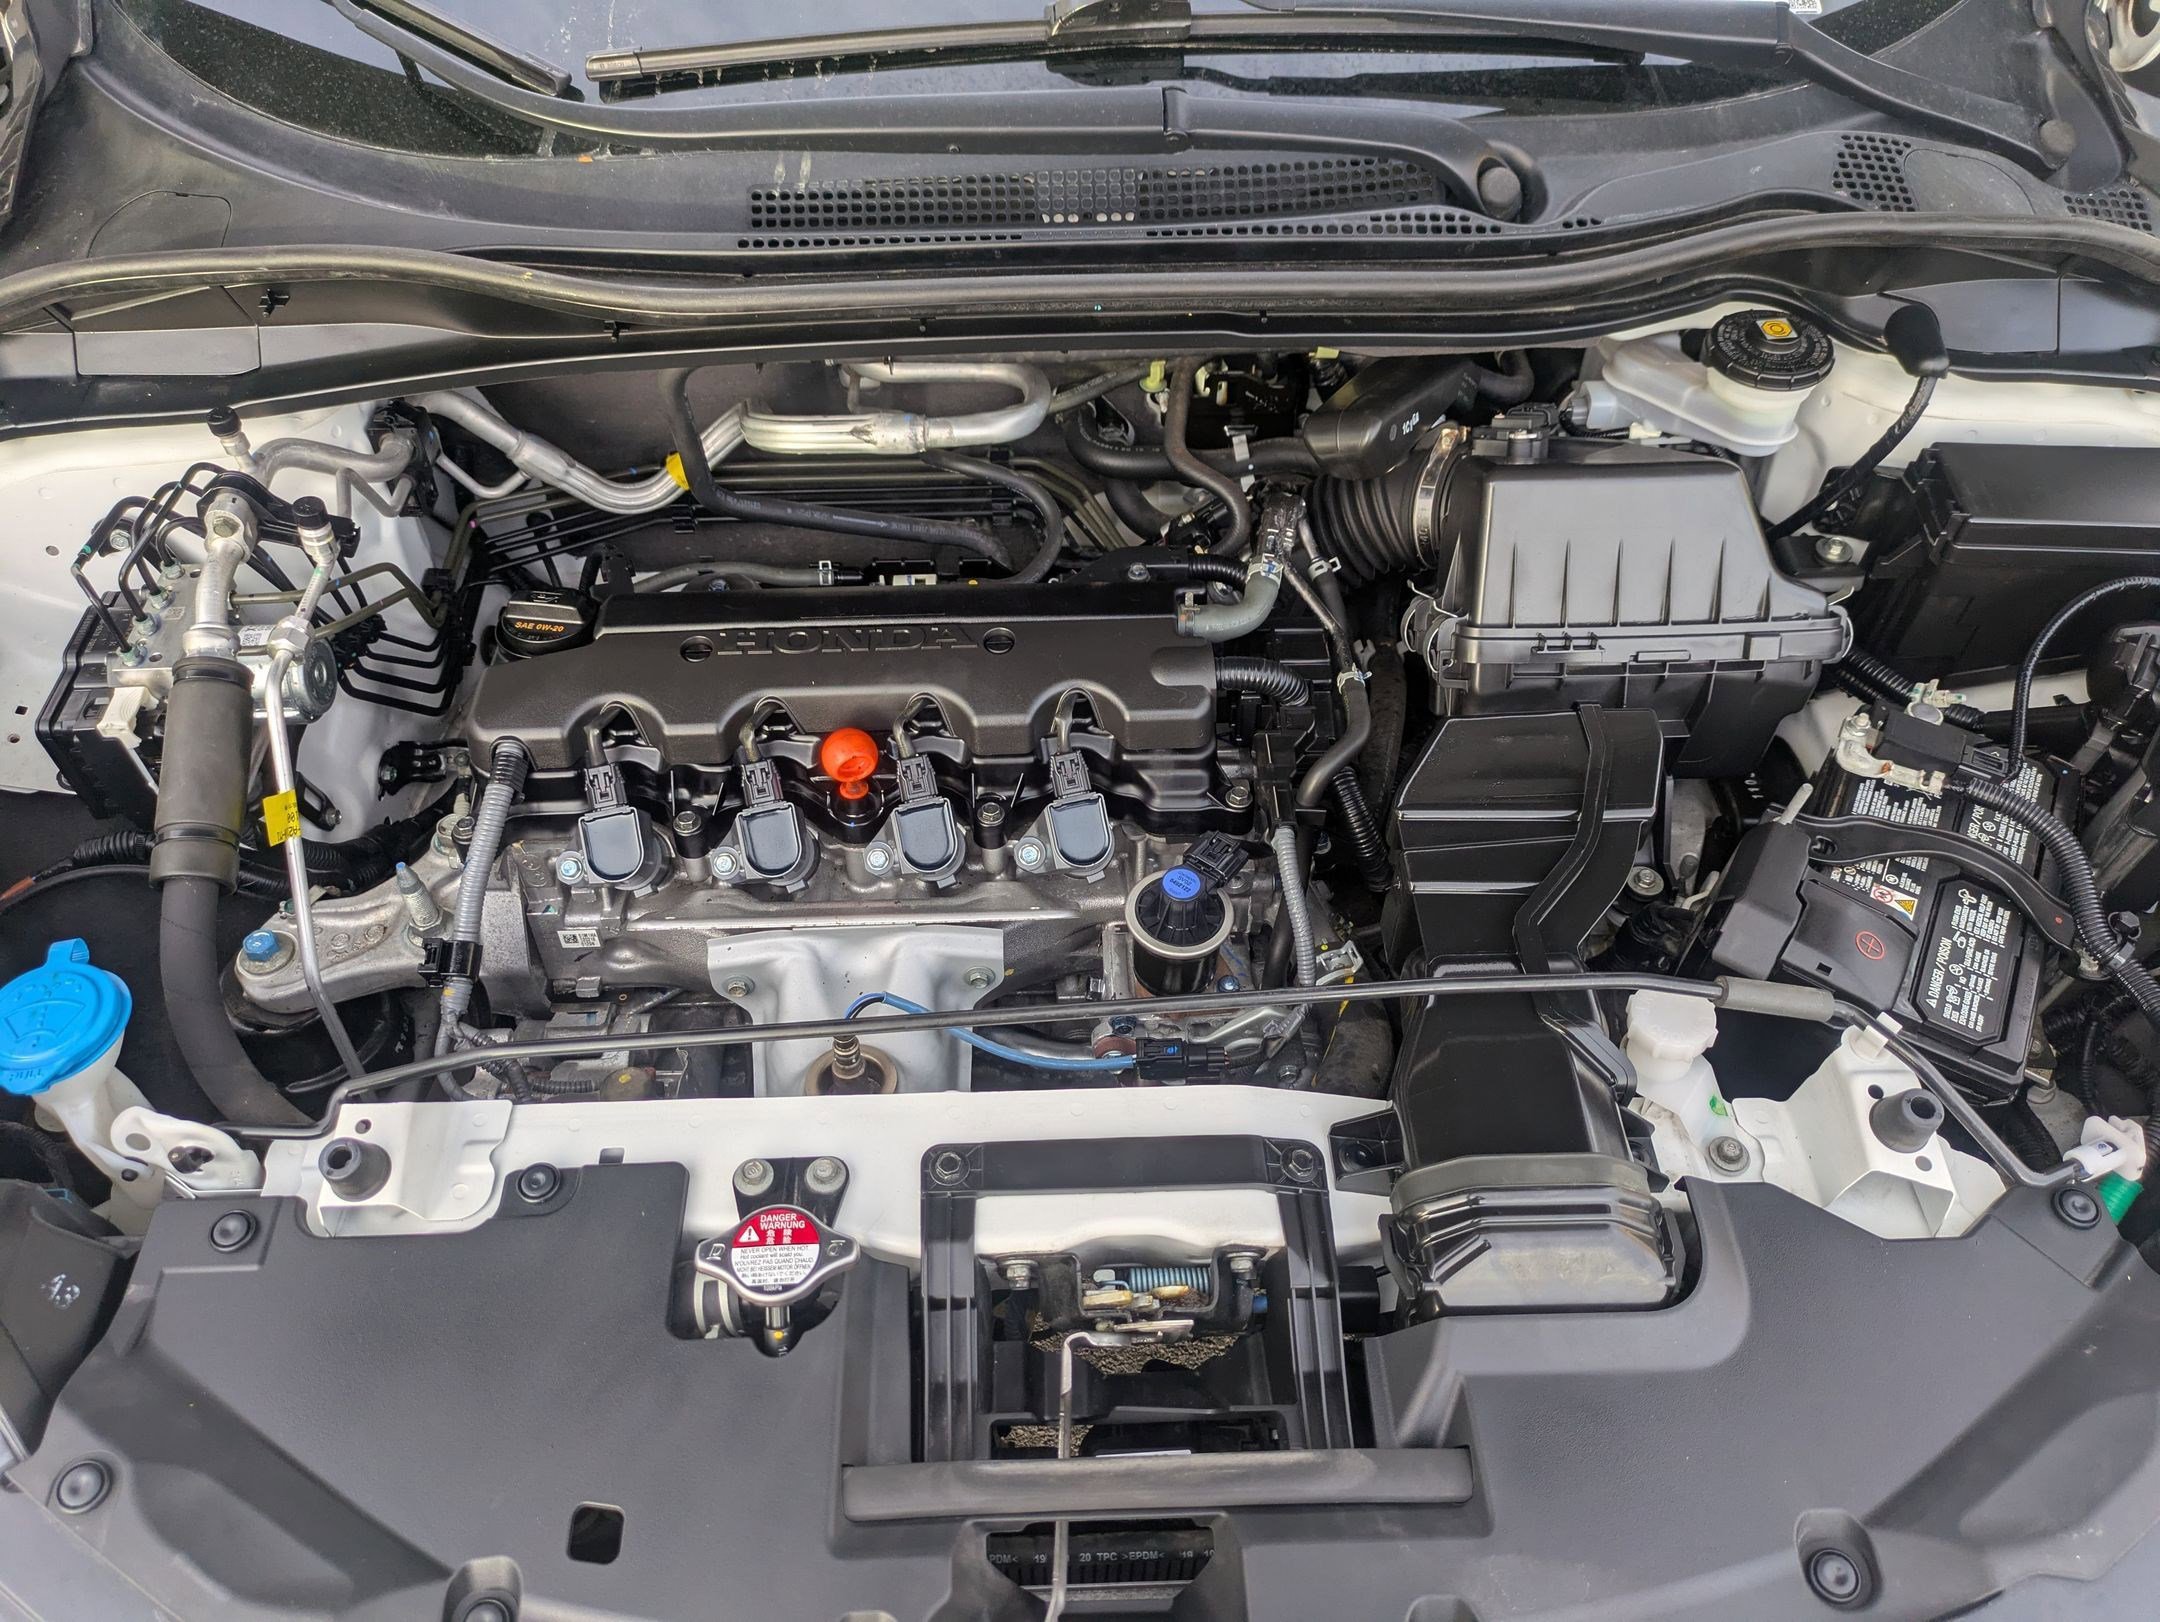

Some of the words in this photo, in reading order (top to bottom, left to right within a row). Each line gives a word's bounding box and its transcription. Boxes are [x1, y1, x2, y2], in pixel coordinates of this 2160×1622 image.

[514, 621, 535, 630] SAE
[535, 623, 565, 633] 0W-20
[717, 626, 978, 656] HONDA
[760, 1213, 797, 1223] DANGER
[760, 1220, 806, 1231] WARNUNG
[1079, 1552, 1092, 1562] 20
[1096, 1551, 1118, 1562] TPC
[1121, 1550, 1165, 1561] >EPDM<
